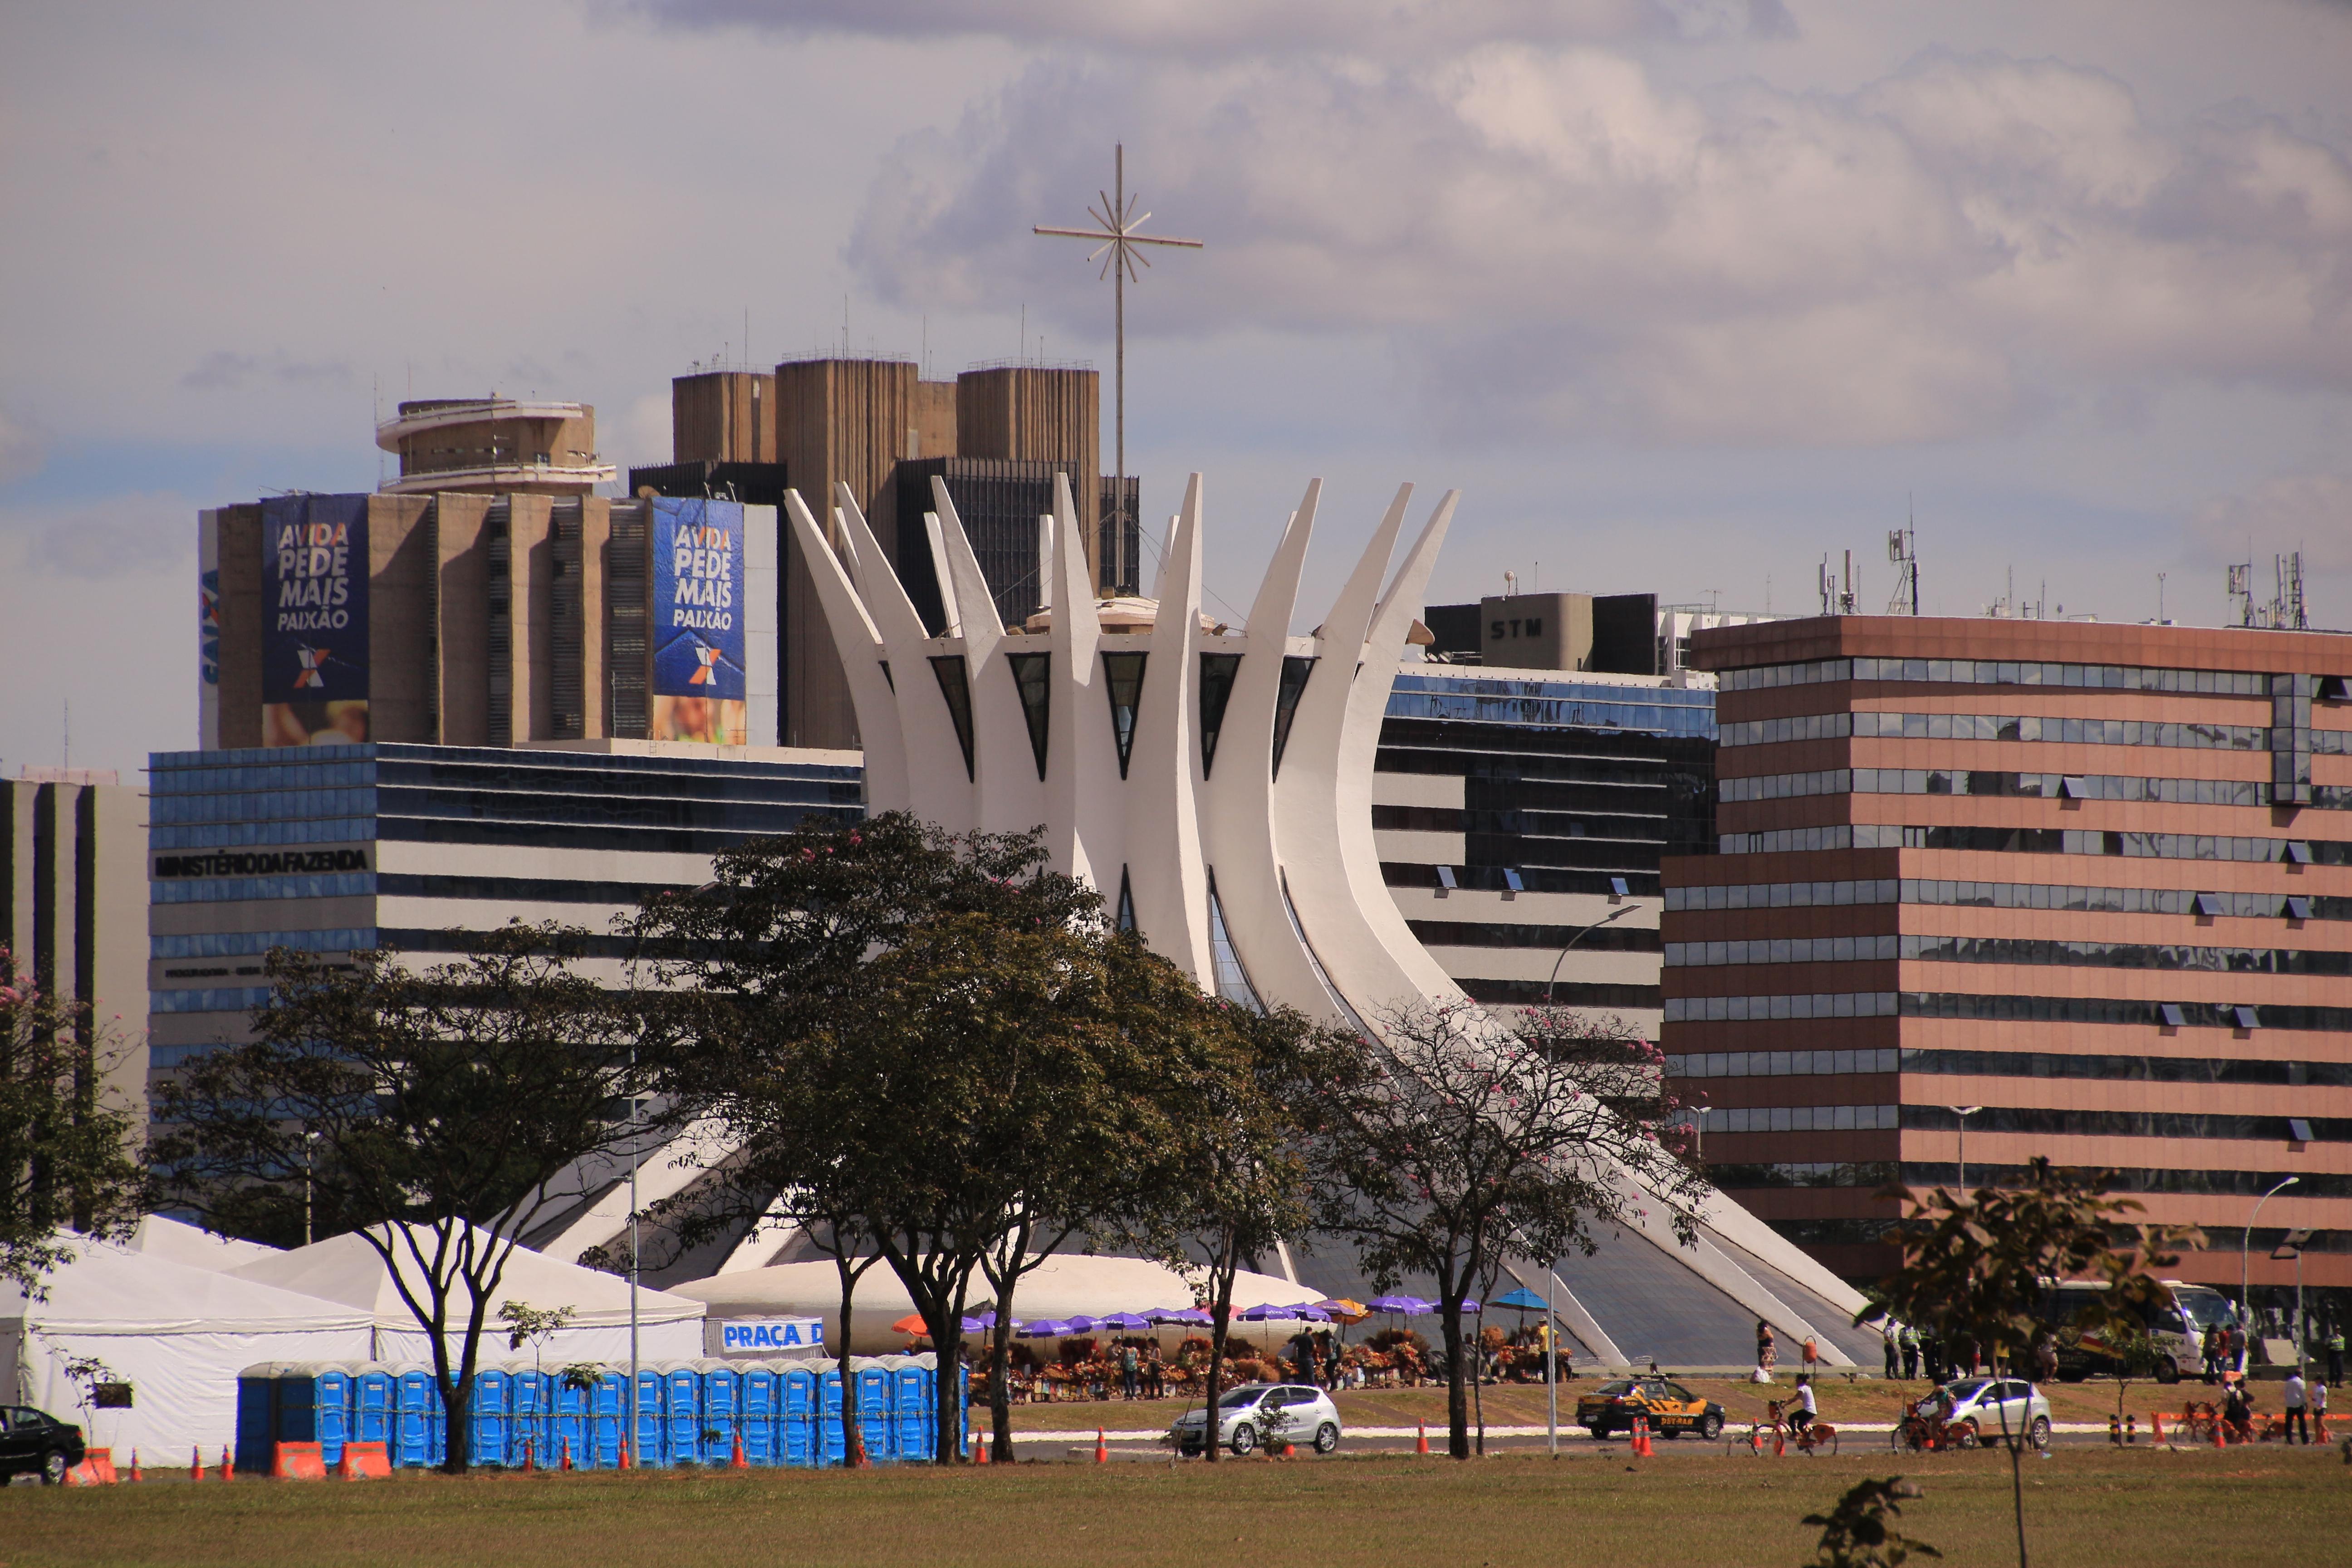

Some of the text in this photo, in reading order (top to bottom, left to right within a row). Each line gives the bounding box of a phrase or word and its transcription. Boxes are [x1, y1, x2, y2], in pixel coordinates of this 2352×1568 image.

[279, 546, 349, 579] PEDE
[675, 548, 731, 580] PEDE
[279, 577, 349, 607] MAIS
[675, 578, 732, 608] MAIS
[278, 605, 349, 631] PAIXÃO
[673, 608, 732, 630] PAIXÃO
[1491, 618, 1542, 639] STM
[156, 849, 367, 877] MINISTÉRIO DA FAZENDA
[725, 1324, 802, 1349] PRAÇA
